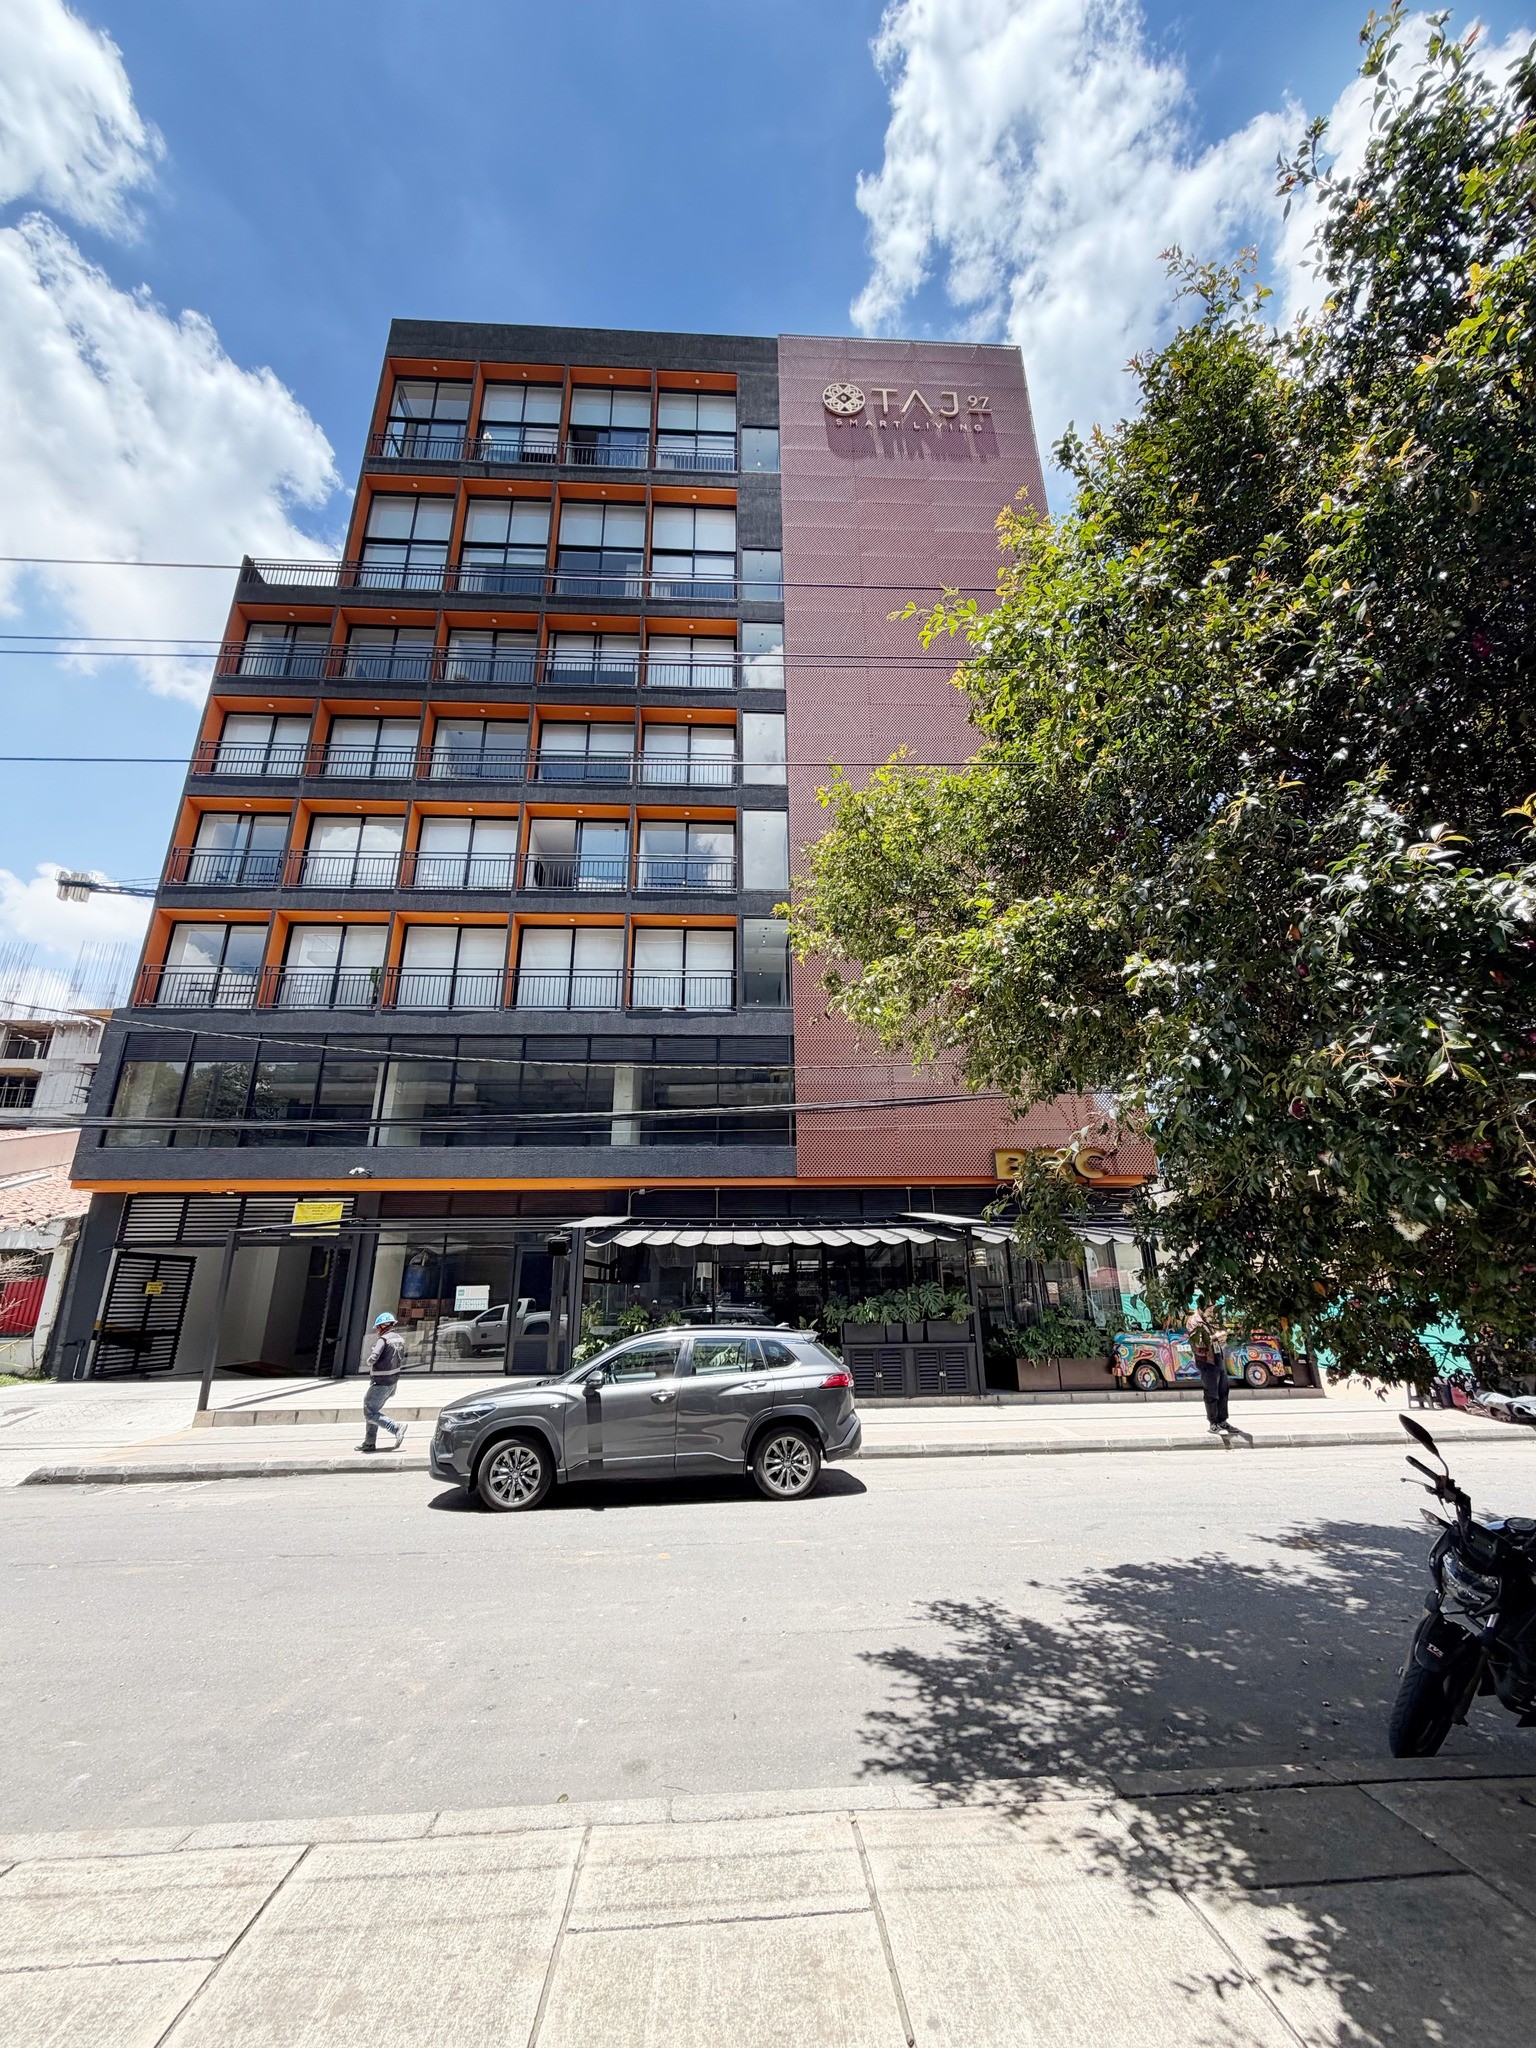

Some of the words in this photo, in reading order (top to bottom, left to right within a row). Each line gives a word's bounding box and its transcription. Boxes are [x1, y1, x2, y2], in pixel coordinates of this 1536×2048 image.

[967, 395, 990, 408] 97
[835, 418, 901, 428] SMART
[912, 421, 983, 432] LIVING
